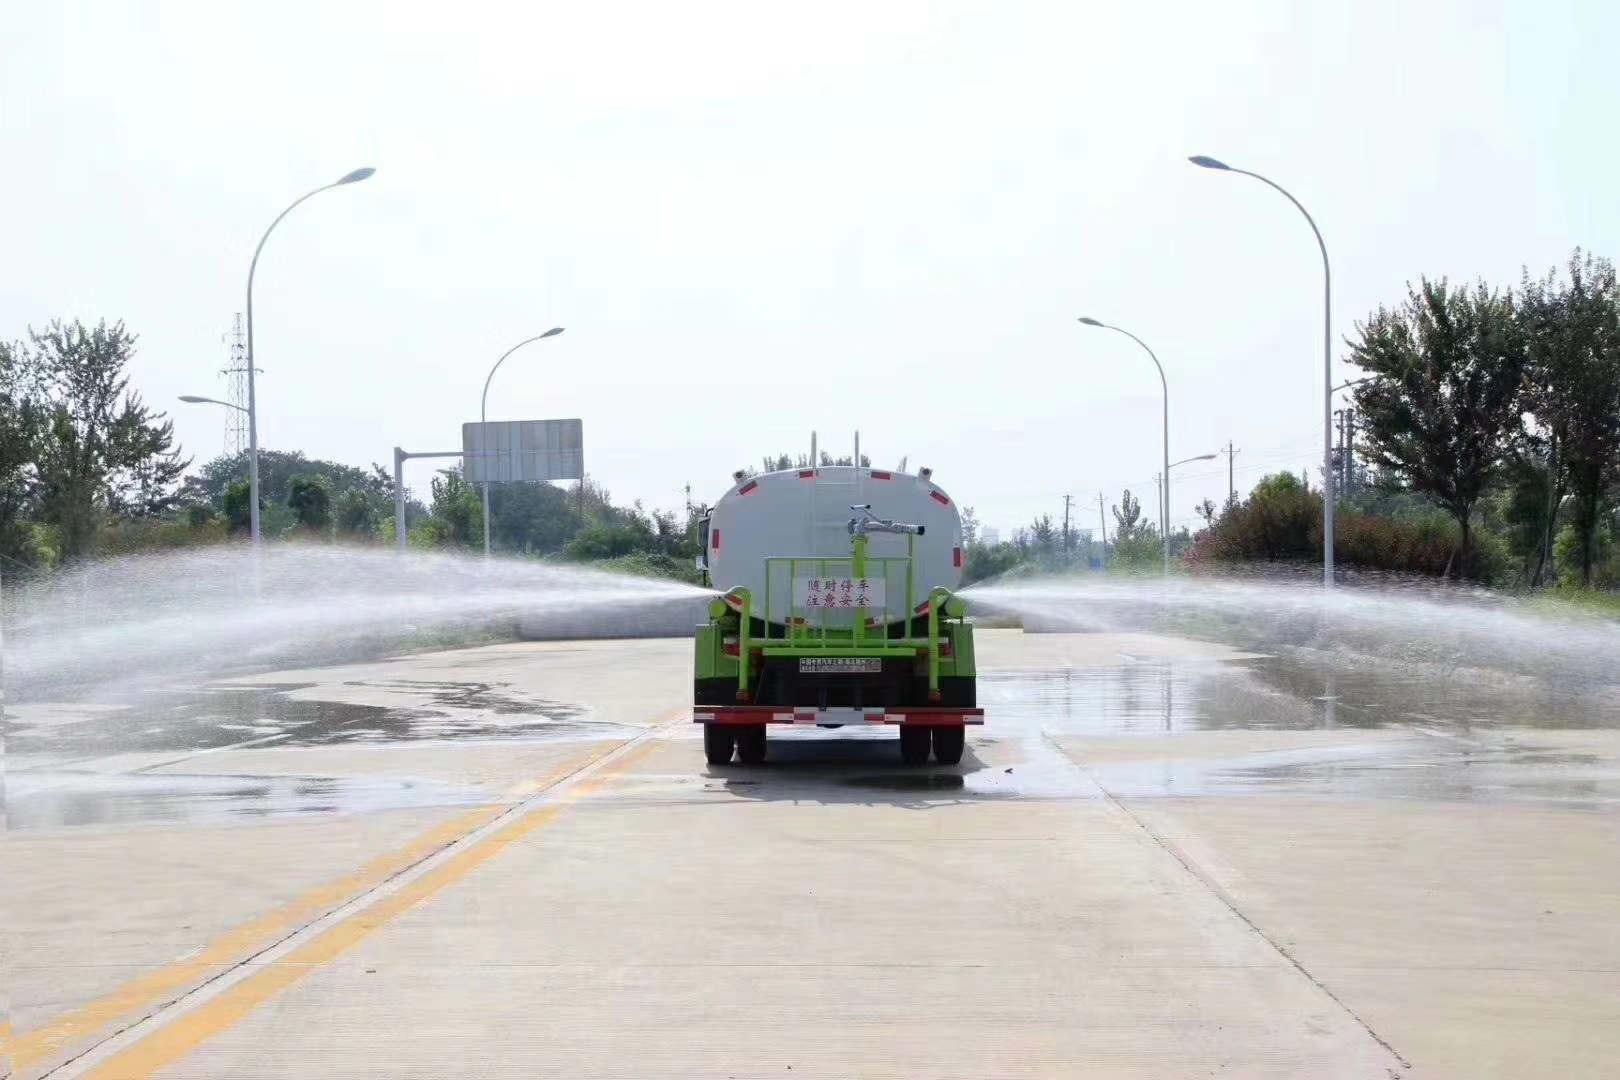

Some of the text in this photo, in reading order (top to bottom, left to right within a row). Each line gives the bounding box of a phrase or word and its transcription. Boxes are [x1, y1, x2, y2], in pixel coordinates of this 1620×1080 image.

[808, 579, 869, 593] 随时停车
[807, 593, 869, 607] 注意安全
